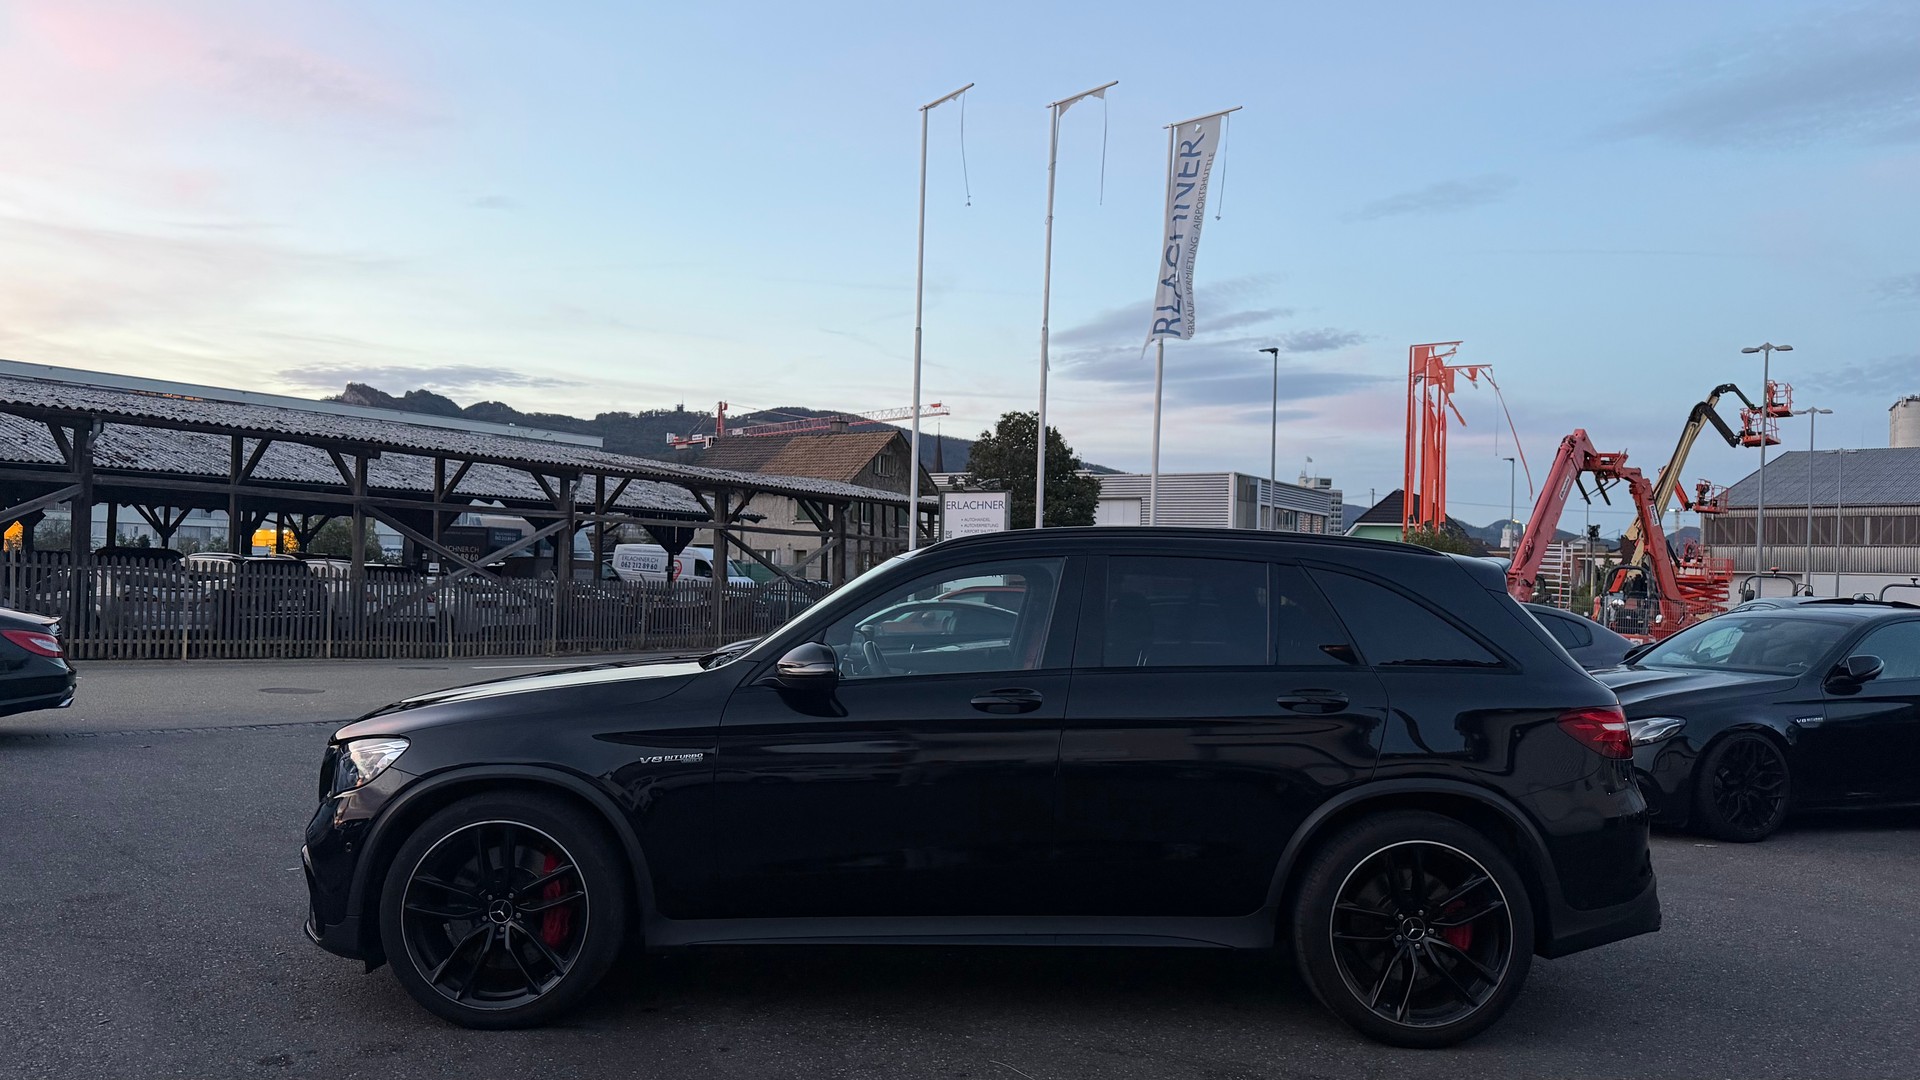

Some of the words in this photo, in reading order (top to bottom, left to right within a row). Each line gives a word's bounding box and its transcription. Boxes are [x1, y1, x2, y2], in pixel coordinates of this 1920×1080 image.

[1152, 132, 1205, 337] RLACHNER
[1186, 237, 1199, 295] VERMIETUNG
[1193, 151, 1215, 230] AIRPORTSHUTTLE
[945, 500, 1005, 510] ERLACHNER
[639, 756, 663, 764] V8
